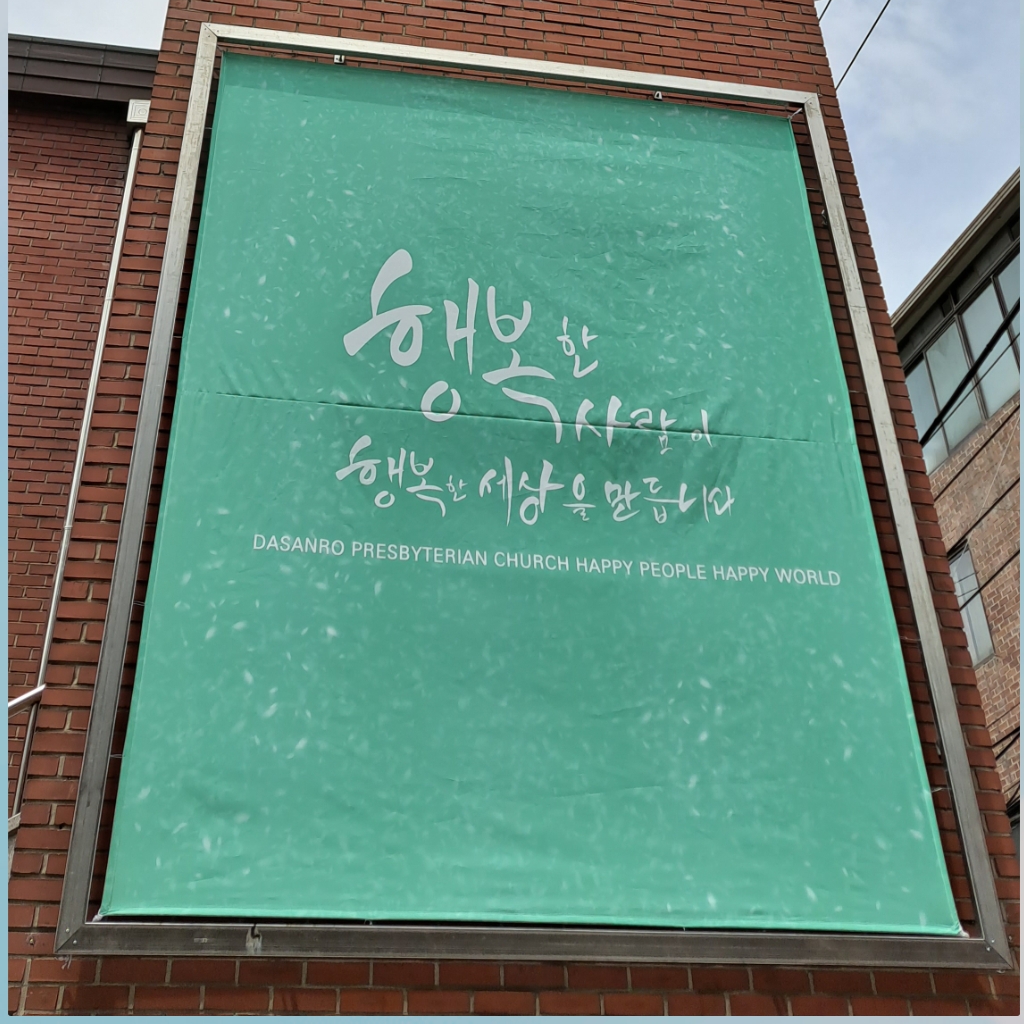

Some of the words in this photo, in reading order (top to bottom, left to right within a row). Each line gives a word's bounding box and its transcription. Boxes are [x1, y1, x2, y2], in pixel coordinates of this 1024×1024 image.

[576, 395, 713, 454] 사람이
[335, 434, 467, 517] 행복한
[479, 456, 597, 526] 세상을
[604, 475, 737, 526] 만듭니다
[252, 533, 346, 557] DASANRO
[351, 540, 489, 567] PRESBYTERIAN
[494, 551, 570, 572] CHURCH
[576, 556, 634, 576] HAPPY
[639, 561, 708, 581] PEOPLE
[713, 565, 771, 584] HAPPY
[775, 568, 841, 587] WORLD
